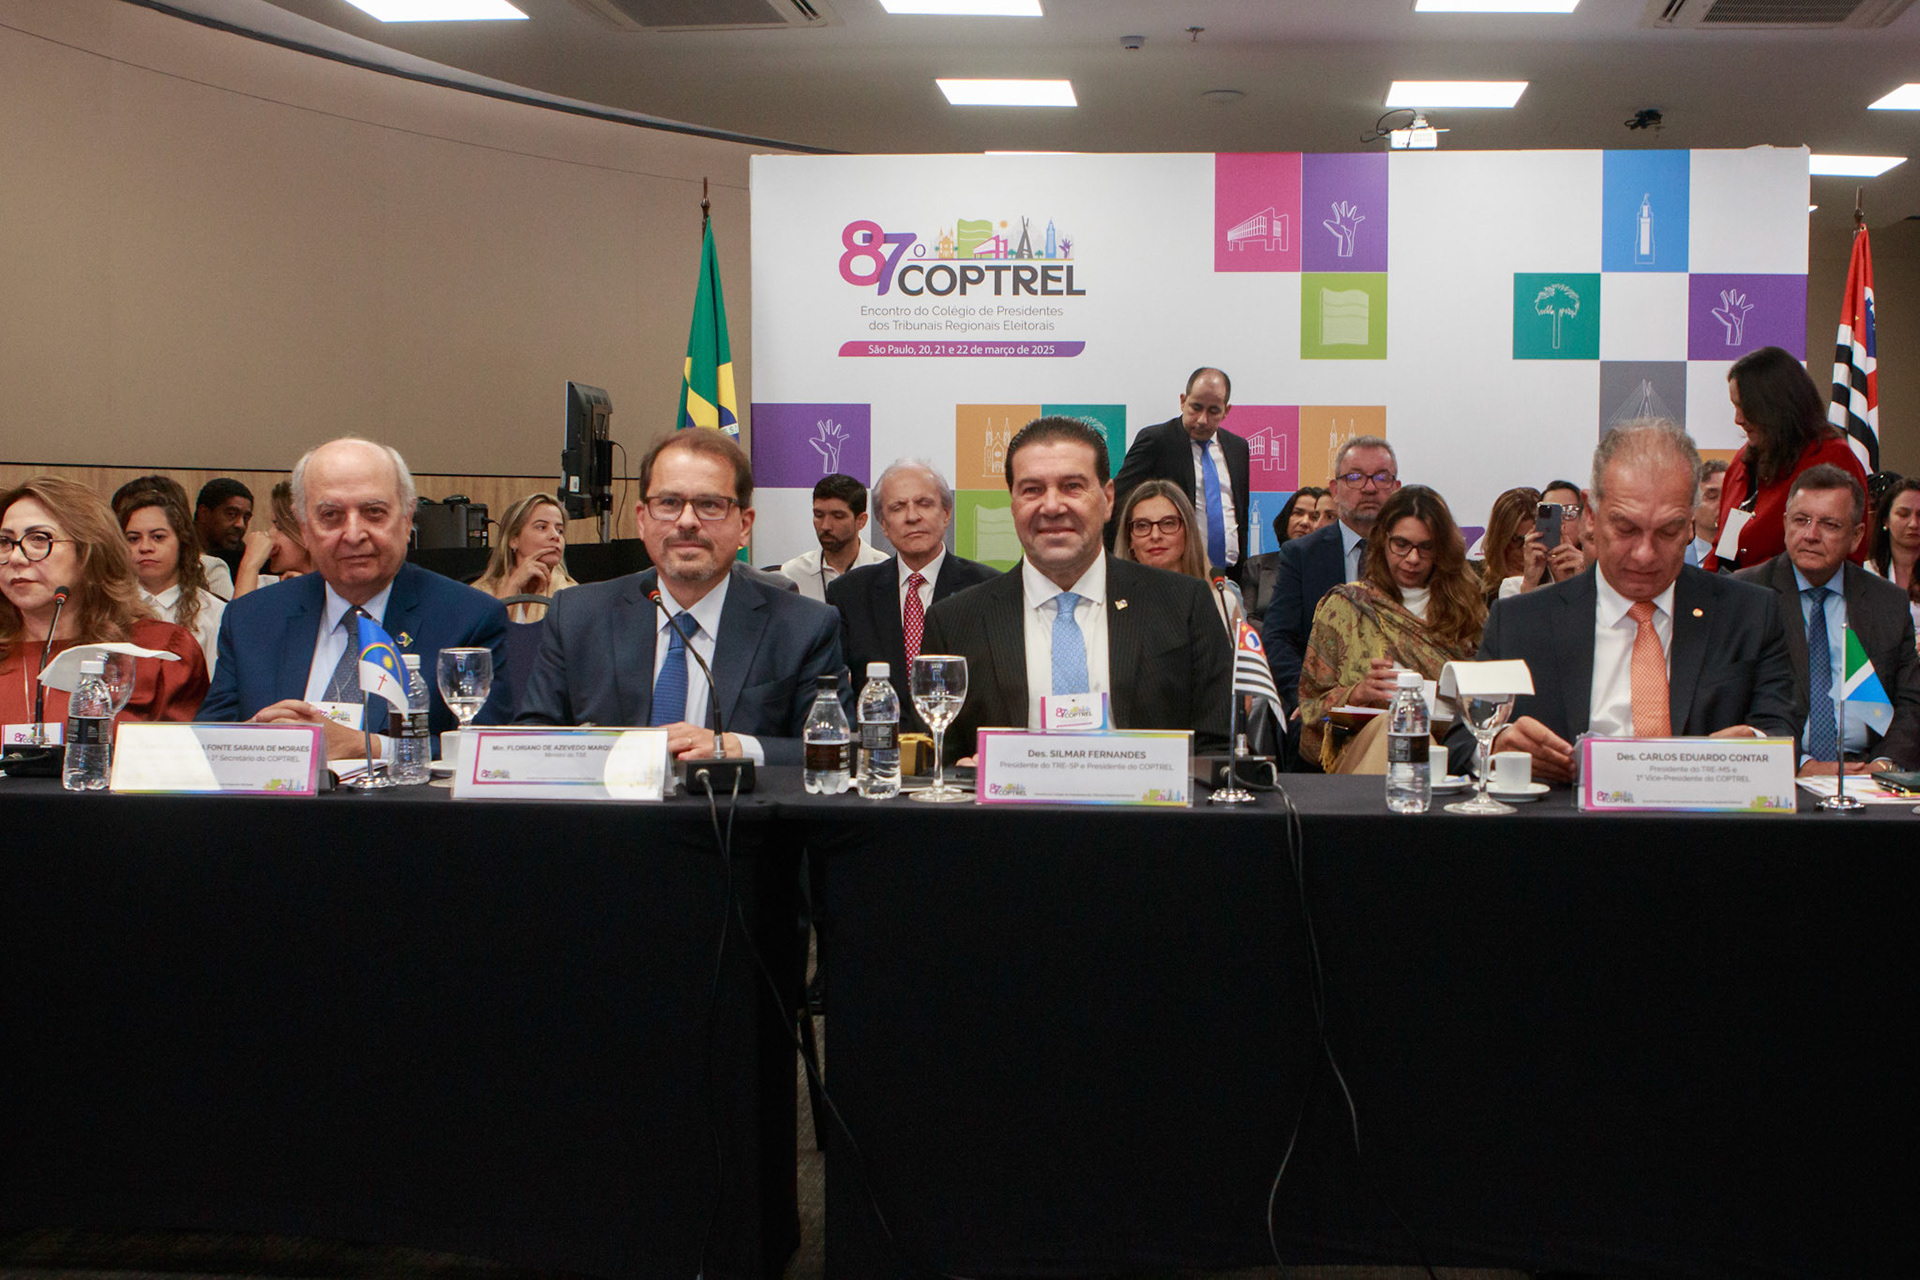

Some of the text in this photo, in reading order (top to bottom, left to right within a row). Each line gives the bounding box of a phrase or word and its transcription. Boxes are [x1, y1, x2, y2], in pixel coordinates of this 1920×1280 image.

[897, 264, 1087, 297] COPTREL
[860, 305, 1064, 319] Encontro do Colégio de Presidentes
[868, 320, 1055, 334] dos Tribunais Regionais Eleitorais
[868, 343, 1055, 357] São Paulo, 20, 21 e 22 de março de 2025
[233, 744, 265, 752] SARAIVA
[278, 745, 310, 753] MORAES
[1027, 749, 1147, 760] Des. SILMAR FERNANDES
[1617, 752, 1769, 763] Des. CARLOS EDUARDO CONTAR
[1000, 761, 1039, 769] Presidente
[1040, 761, 1050, 769] do
[1052, 762, 1079, 770] TRE-SP
[1087, 762, 1126, 770] Presidente
[1127, 762, 1138, 771] do
[1139, 763, 1174, 771] COPTREL
[1649, 765, 1688, 773] Presidente
[1690, 765, 1700, 773] do
[1645, 774, 1703, 782] Vice-Presidente
[1704, 774, 1715, 782] do
[1716, 774, 1751, 783] COPTREL
